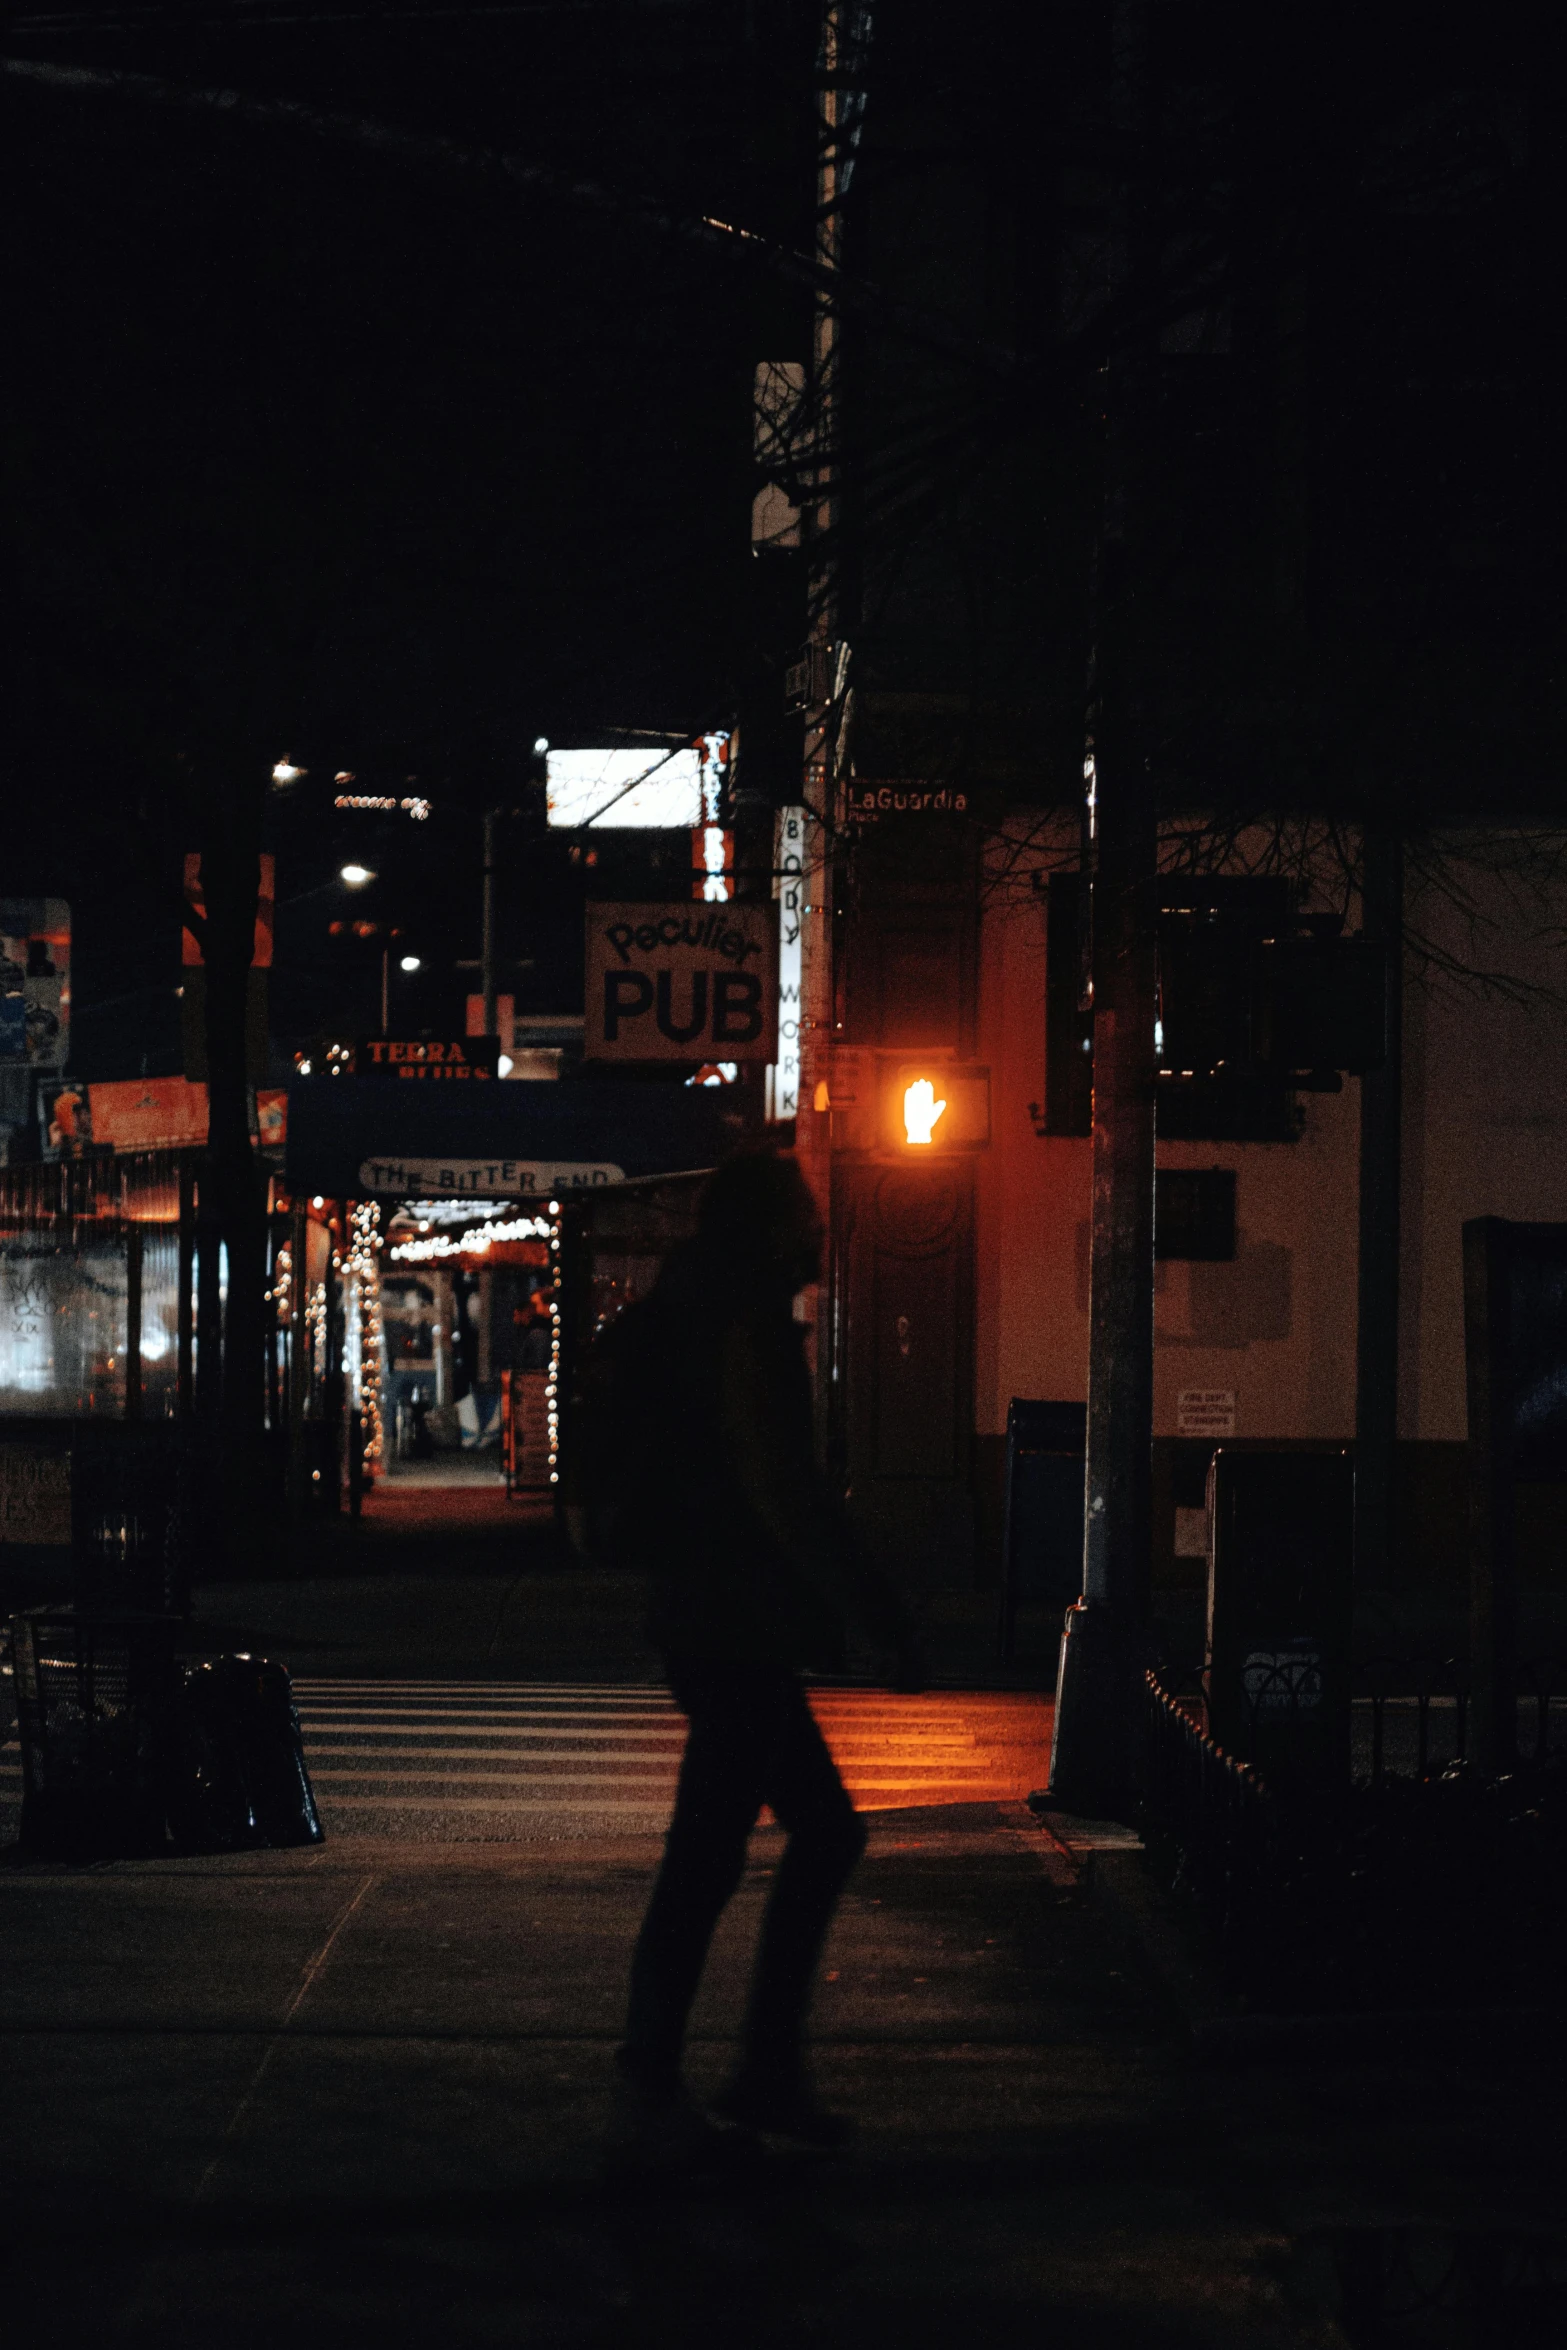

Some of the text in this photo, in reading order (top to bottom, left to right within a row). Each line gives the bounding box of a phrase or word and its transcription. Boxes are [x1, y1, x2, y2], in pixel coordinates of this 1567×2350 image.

[847, 786, 969, 811] LaGuardia
[606, 914, 762, 964] Peculier
[779, 818, 800, 1110] BODY WORK
[604, 969, 763, 1042] PUB
[366, 1042, 467, 1064] TERRA
[371, 1162, 609, 1193] THE BITTER END
